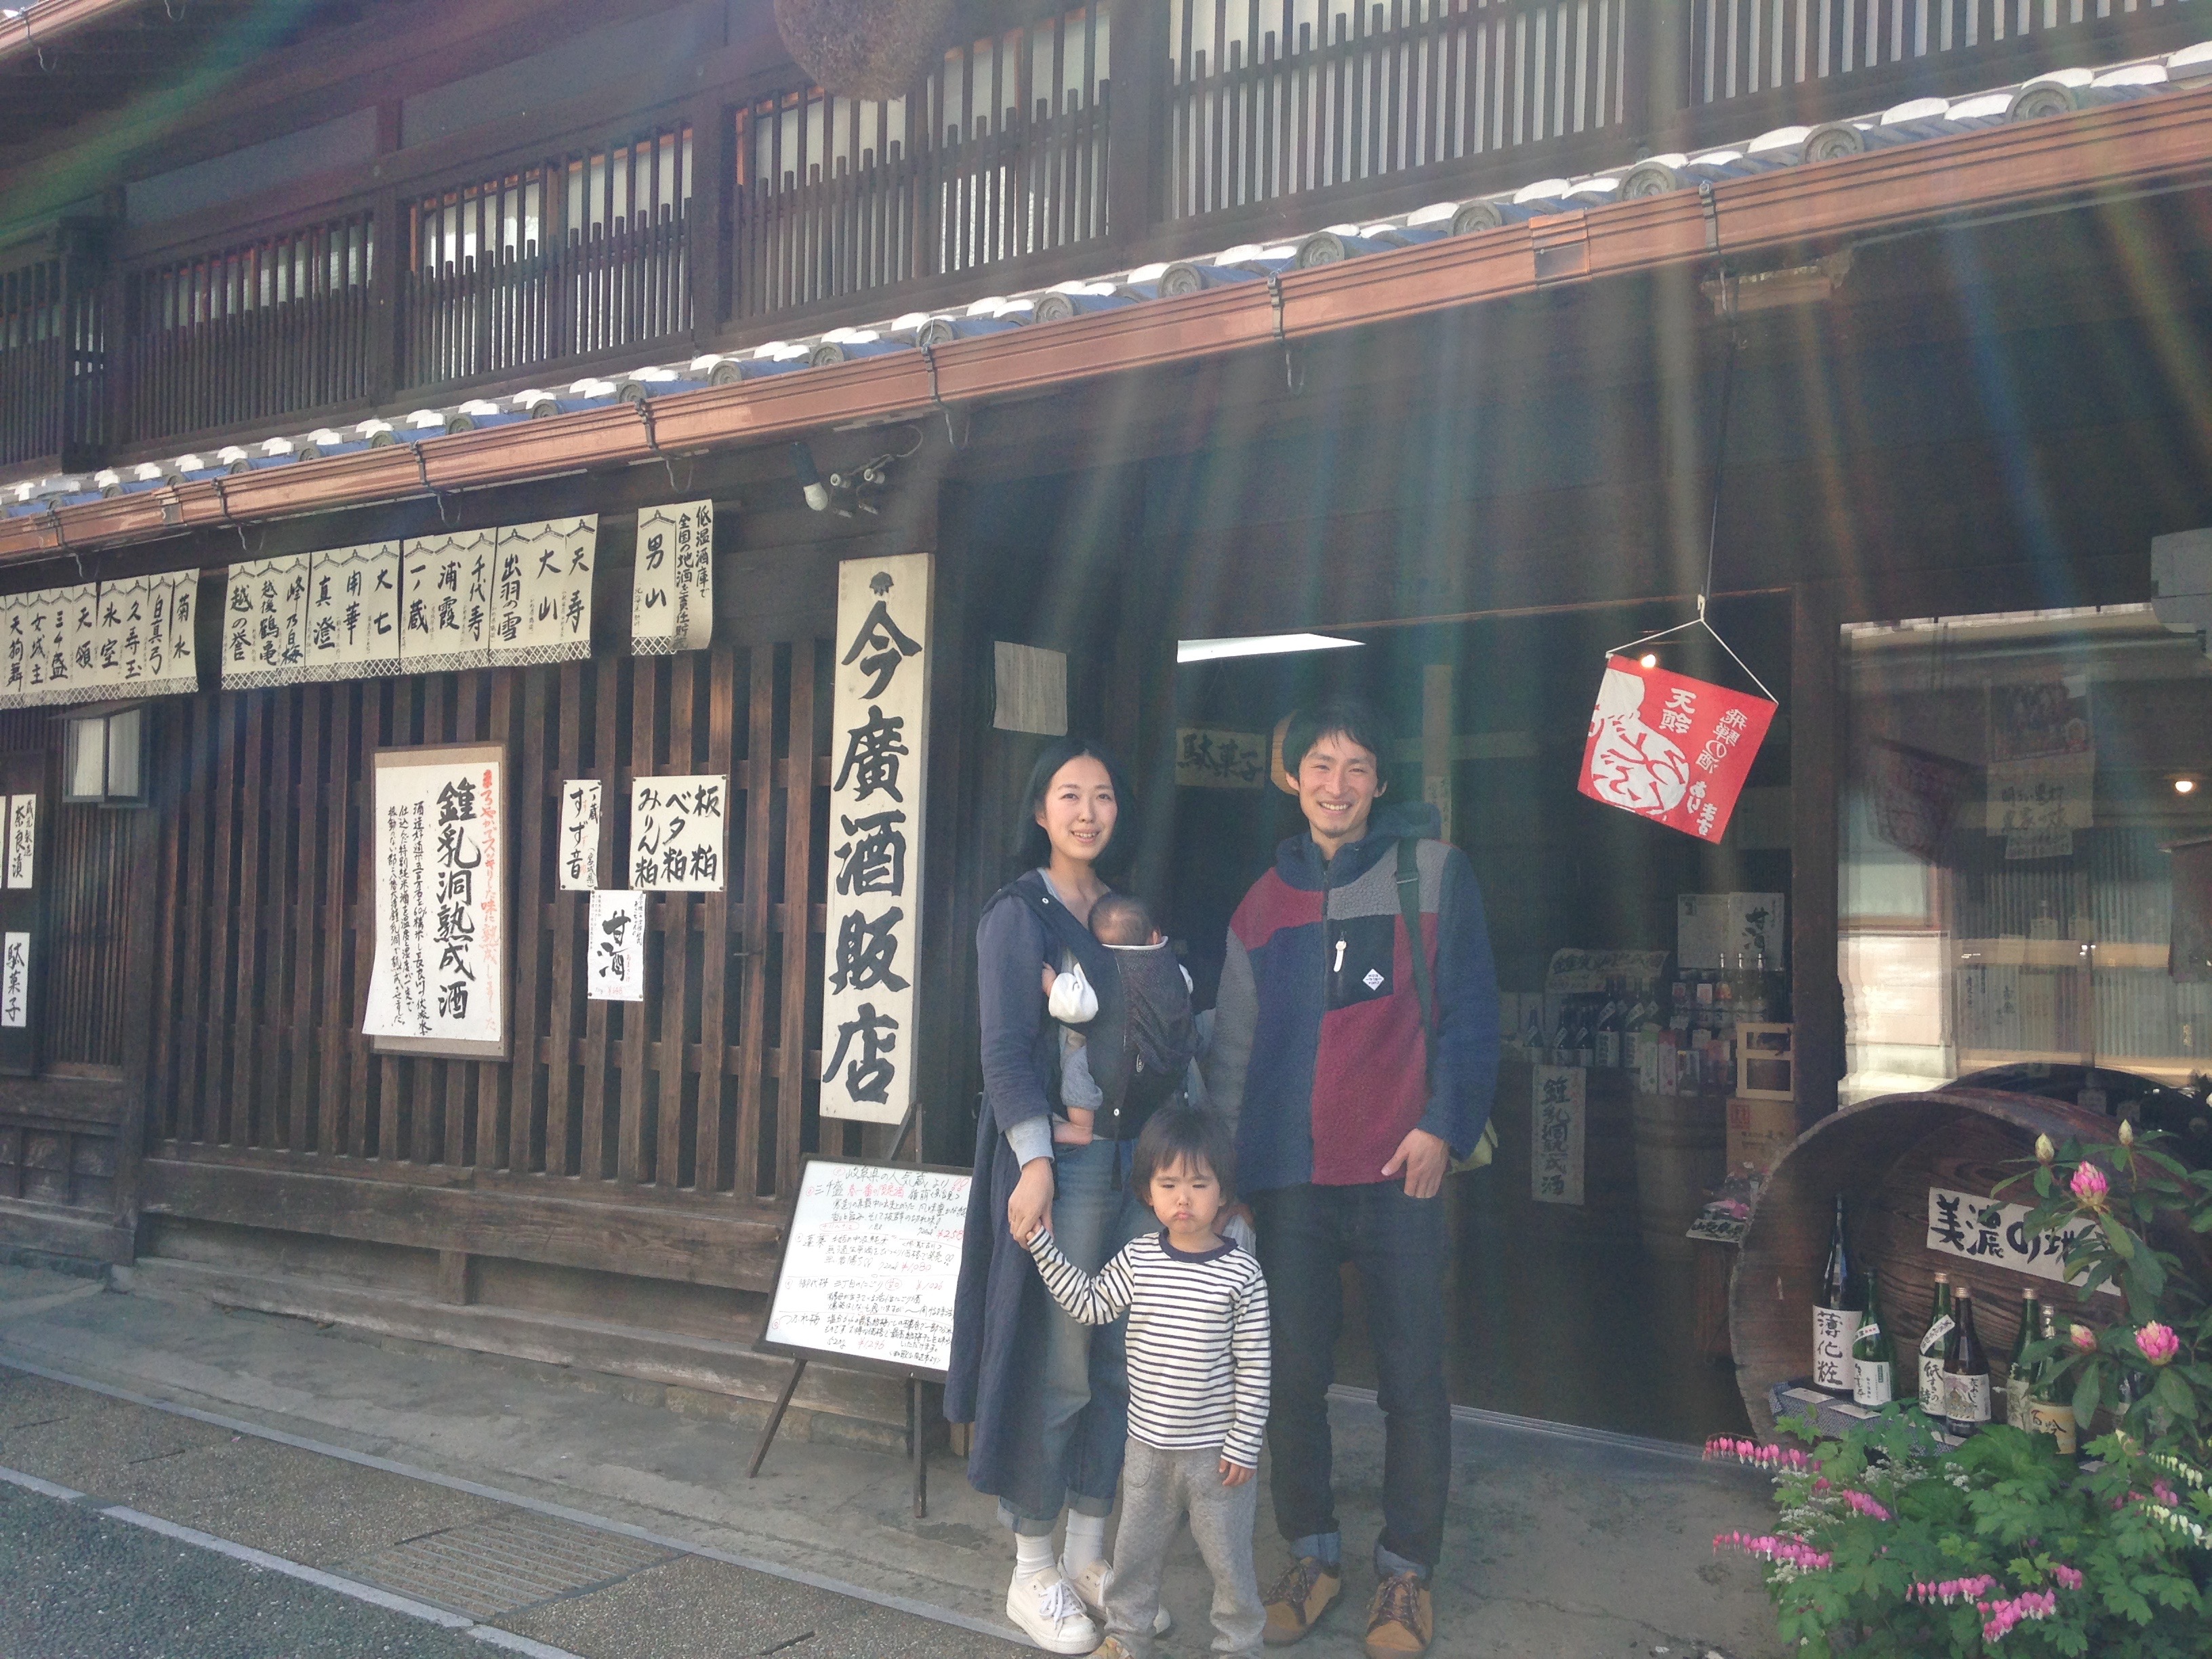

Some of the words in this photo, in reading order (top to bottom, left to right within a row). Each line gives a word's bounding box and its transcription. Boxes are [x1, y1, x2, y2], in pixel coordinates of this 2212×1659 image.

[536, 548, 561, 622] 大山
[566, 546, 589, 634] 天寿
[645, 533, 667, 609] 男山
[695, 505, 712, 598] 低温酒庫で
[148, 593, 163, 675] 白真弓
[173, 592, 190, 659] 菊水
[229, 584, 253, 661] 越の誉
[259, 579, 279, 665] 越後鶴亀
[280, 575, 305, 666] 峰乃白梅
[313, 575, 336, 649] 真澄
[373, 568, 393, 635] 大七
[437, 560, 462, 631] 浦霞
[468, 554, 486, 642] 千代寿
[497, 553, 522, 641] 出羽の雪
[6, 615, 23, 692] 天狗舞
[30, 612, 47, 684] 女城主
[49, 610, 68, 679] 三千盛
[75, 607, 94, 669] 天領
[100, 601, 121, 669] 氷室
[124, 600, 142, 680] 久寿玉
[12, 804, 24, 879] 奈良漬
[566, 787, 588, 880] すず音
[635, 787, 661, 888] みりん粕
[691, 784, 721, 882] 板粕
[823, 599, 923, 1102] 今廣酒販店
[434, 777, 481, 1019] 鍾乳洞熟成酒
[5, 942, 25, 1021] 駄菓子
[596, 909, 632, 981] 甘酒
[1931, 1194, 2097, 1269] 美濃の地
[1818, 1310, 1843, 1387] 薄化粧
